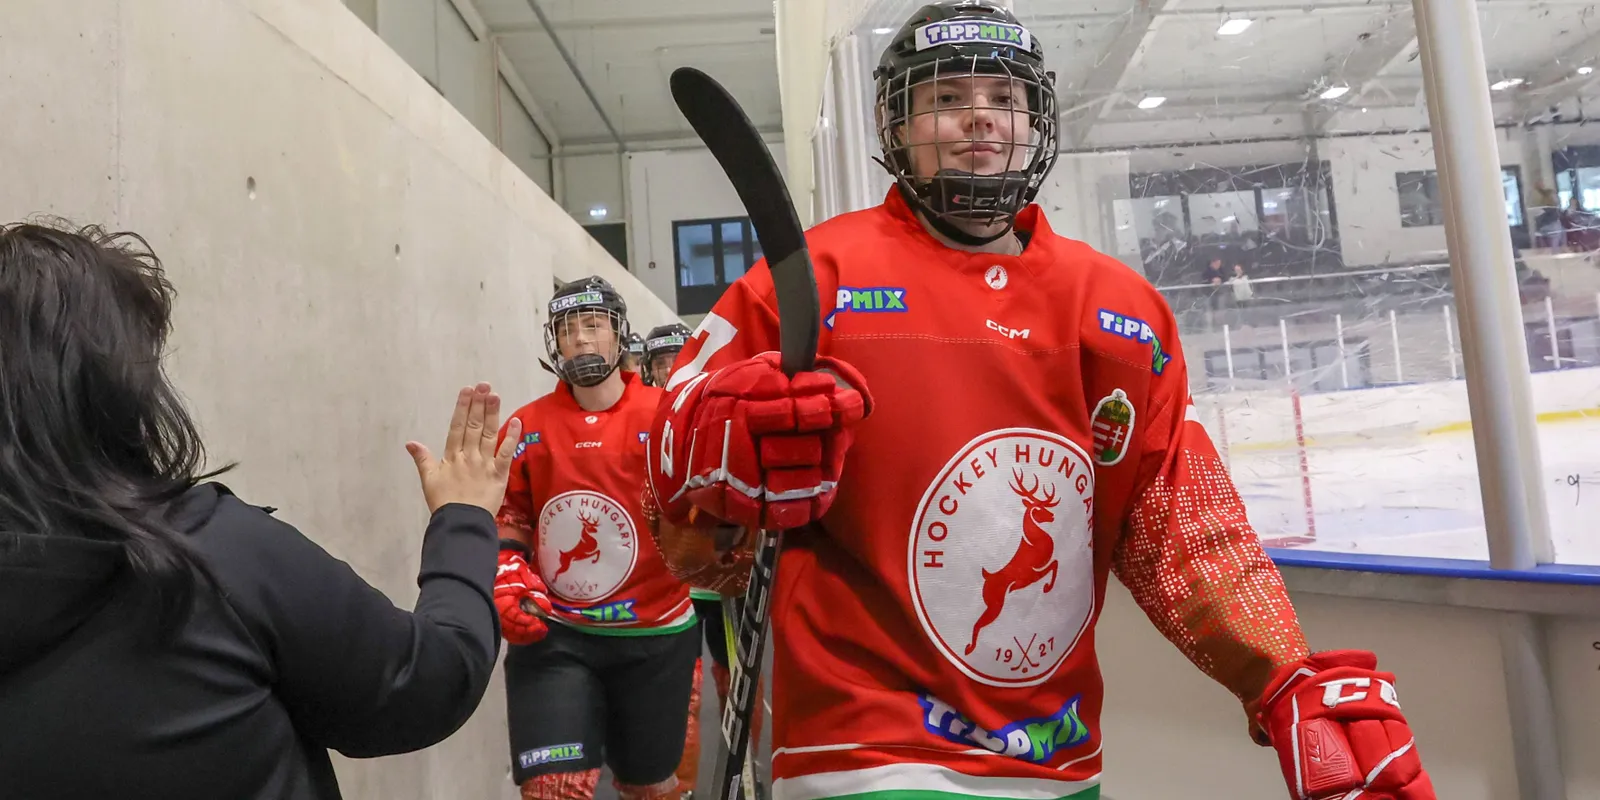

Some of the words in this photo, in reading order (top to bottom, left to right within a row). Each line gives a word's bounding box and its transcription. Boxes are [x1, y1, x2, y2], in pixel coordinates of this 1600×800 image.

[927, 23, 1022, 45] TiPPMIX
[550, 293, 602, 311] TiPPMIX
[986, 319, 1031, 339] CCM
[575, 441, 602, 449] CCM
[924, 447, 999, 568] HOCKEY
[541, 500, 573, 546] HOCKEY
[580, 498, 631, 549] HUNGARY
[995, 647, 1013, 663] 19
[520, 744, 582, 767] TiPPMIX
